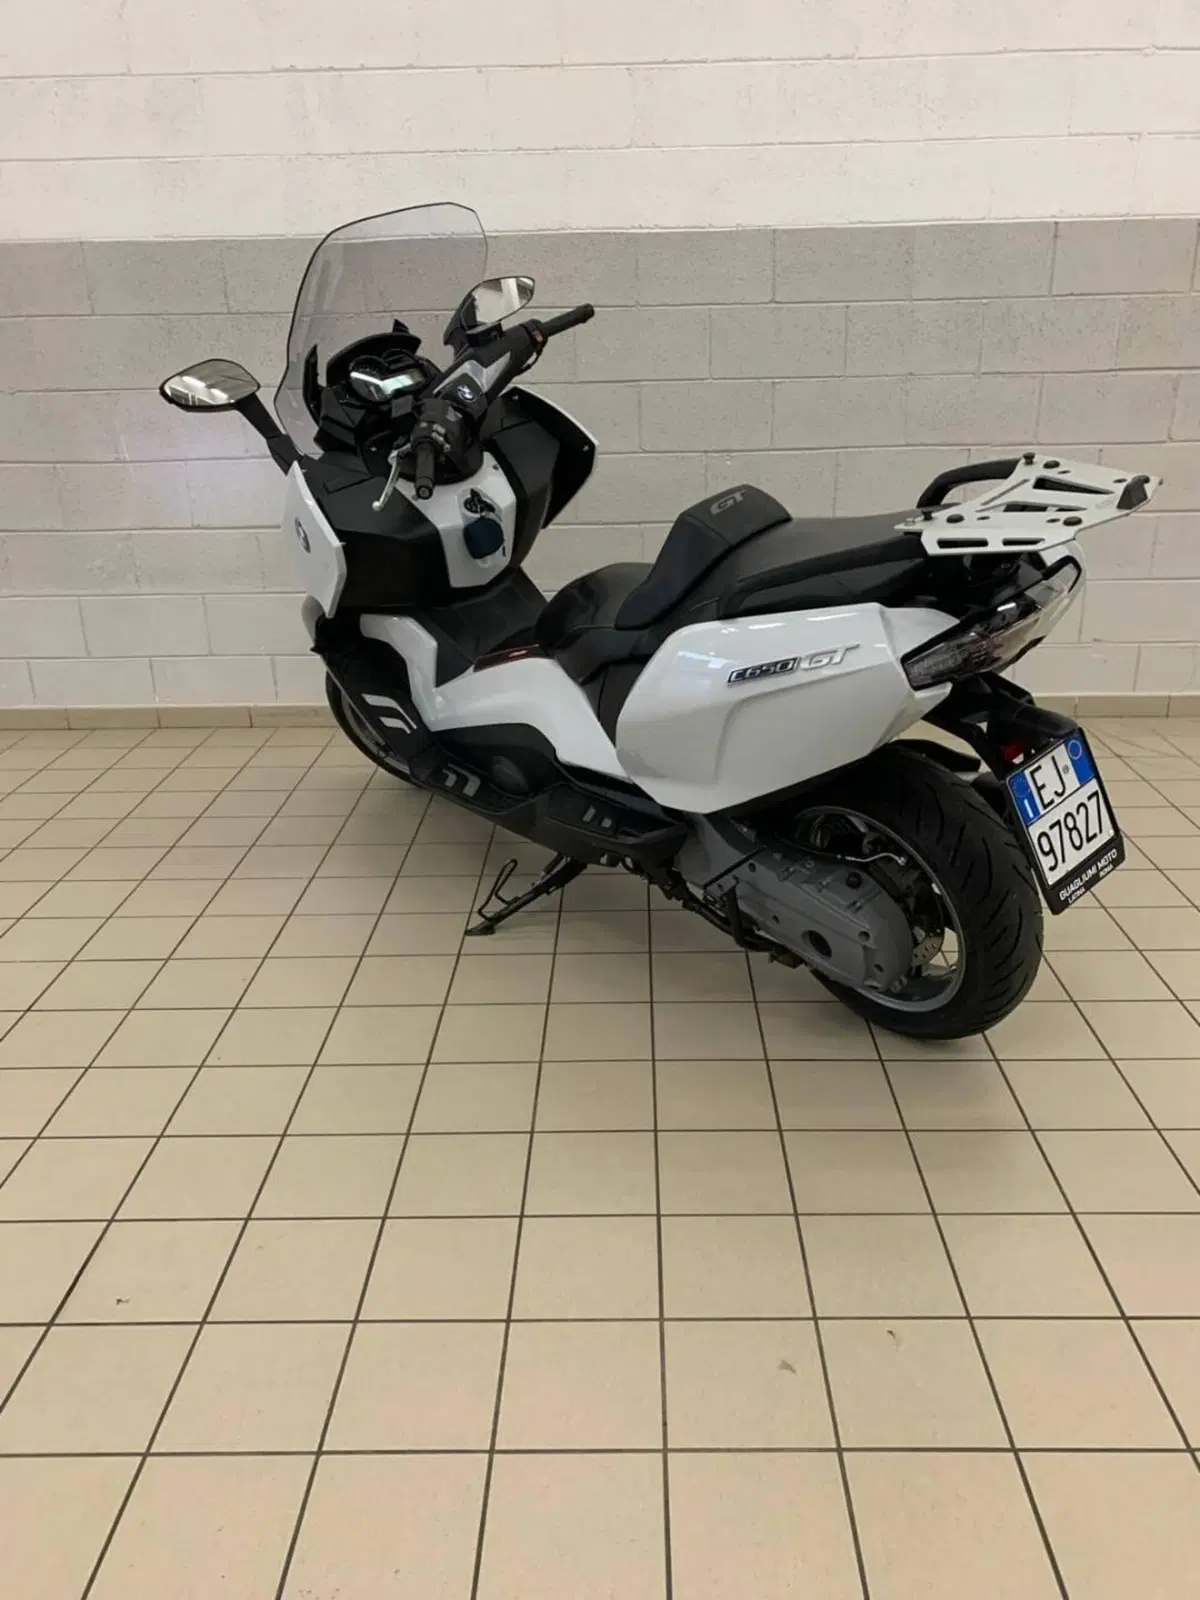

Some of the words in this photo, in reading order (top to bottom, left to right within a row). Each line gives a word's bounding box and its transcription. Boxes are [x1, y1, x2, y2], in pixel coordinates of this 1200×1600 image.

[710, 489, 745, 514] GT
[801, 644, 860, 670] GT
[1029, 755, 1067, 811] EJ
[1037, 790, 1104, 872] 97827
[1097, 848, 1118, 871] MOTO
